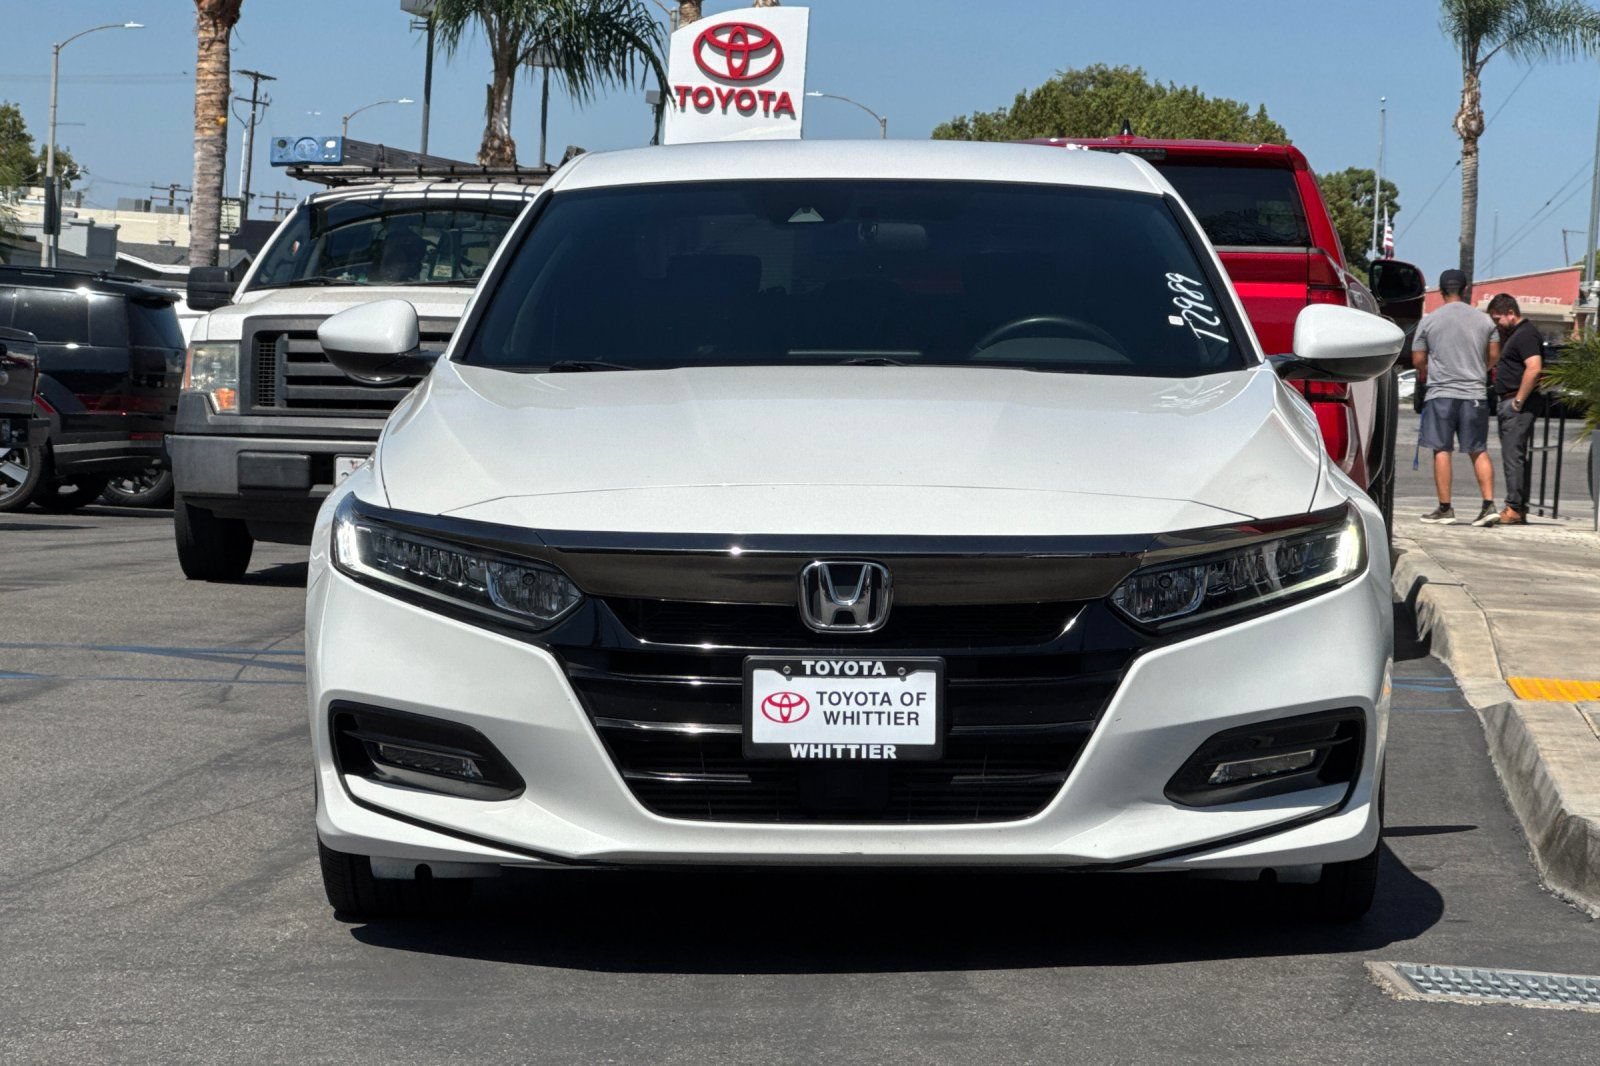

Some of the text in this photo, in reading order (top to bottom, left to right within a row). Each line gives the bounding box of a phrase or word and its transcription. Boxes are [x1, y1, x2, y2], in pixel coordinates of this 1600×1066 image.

[674, 85, 795, 115] TOYOTA
[802, 660, 887, 676] TOYOTA
[816, 691, 928, 707] TOYOTA OF
[823, 710, 920, 726] WHITTIER
[789, 743, 897, 760] WHITTIER
